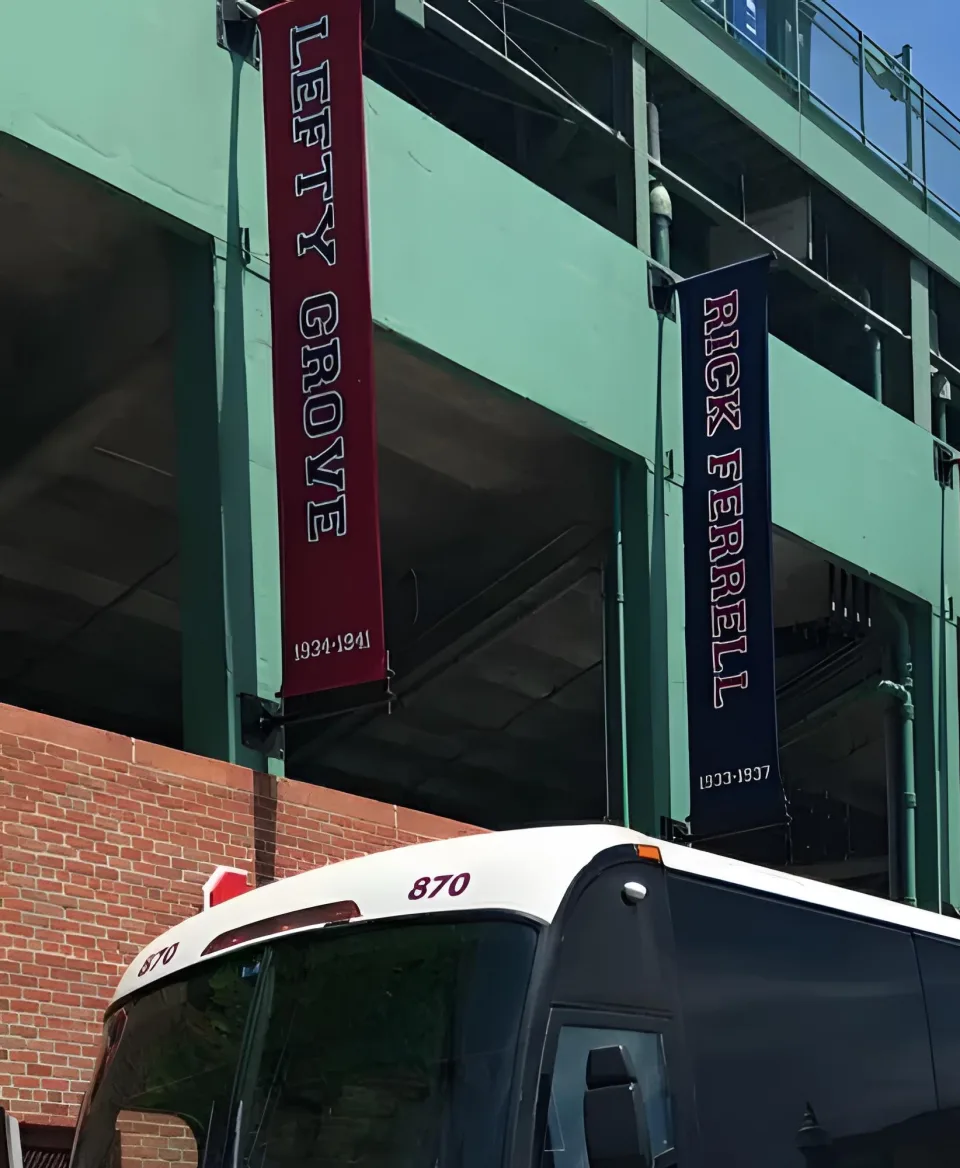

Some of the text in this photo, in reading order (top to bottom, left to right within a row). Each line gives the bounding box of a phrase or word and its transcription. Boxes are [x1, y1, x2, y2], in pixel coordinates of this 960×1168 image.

[290, 15, 347, 542] LEFTY GROVE
[704, 288, 749, 709] RICK FERRELL
[137, 941, 180, 978] 870
[407, 872, 472, 901] 870
